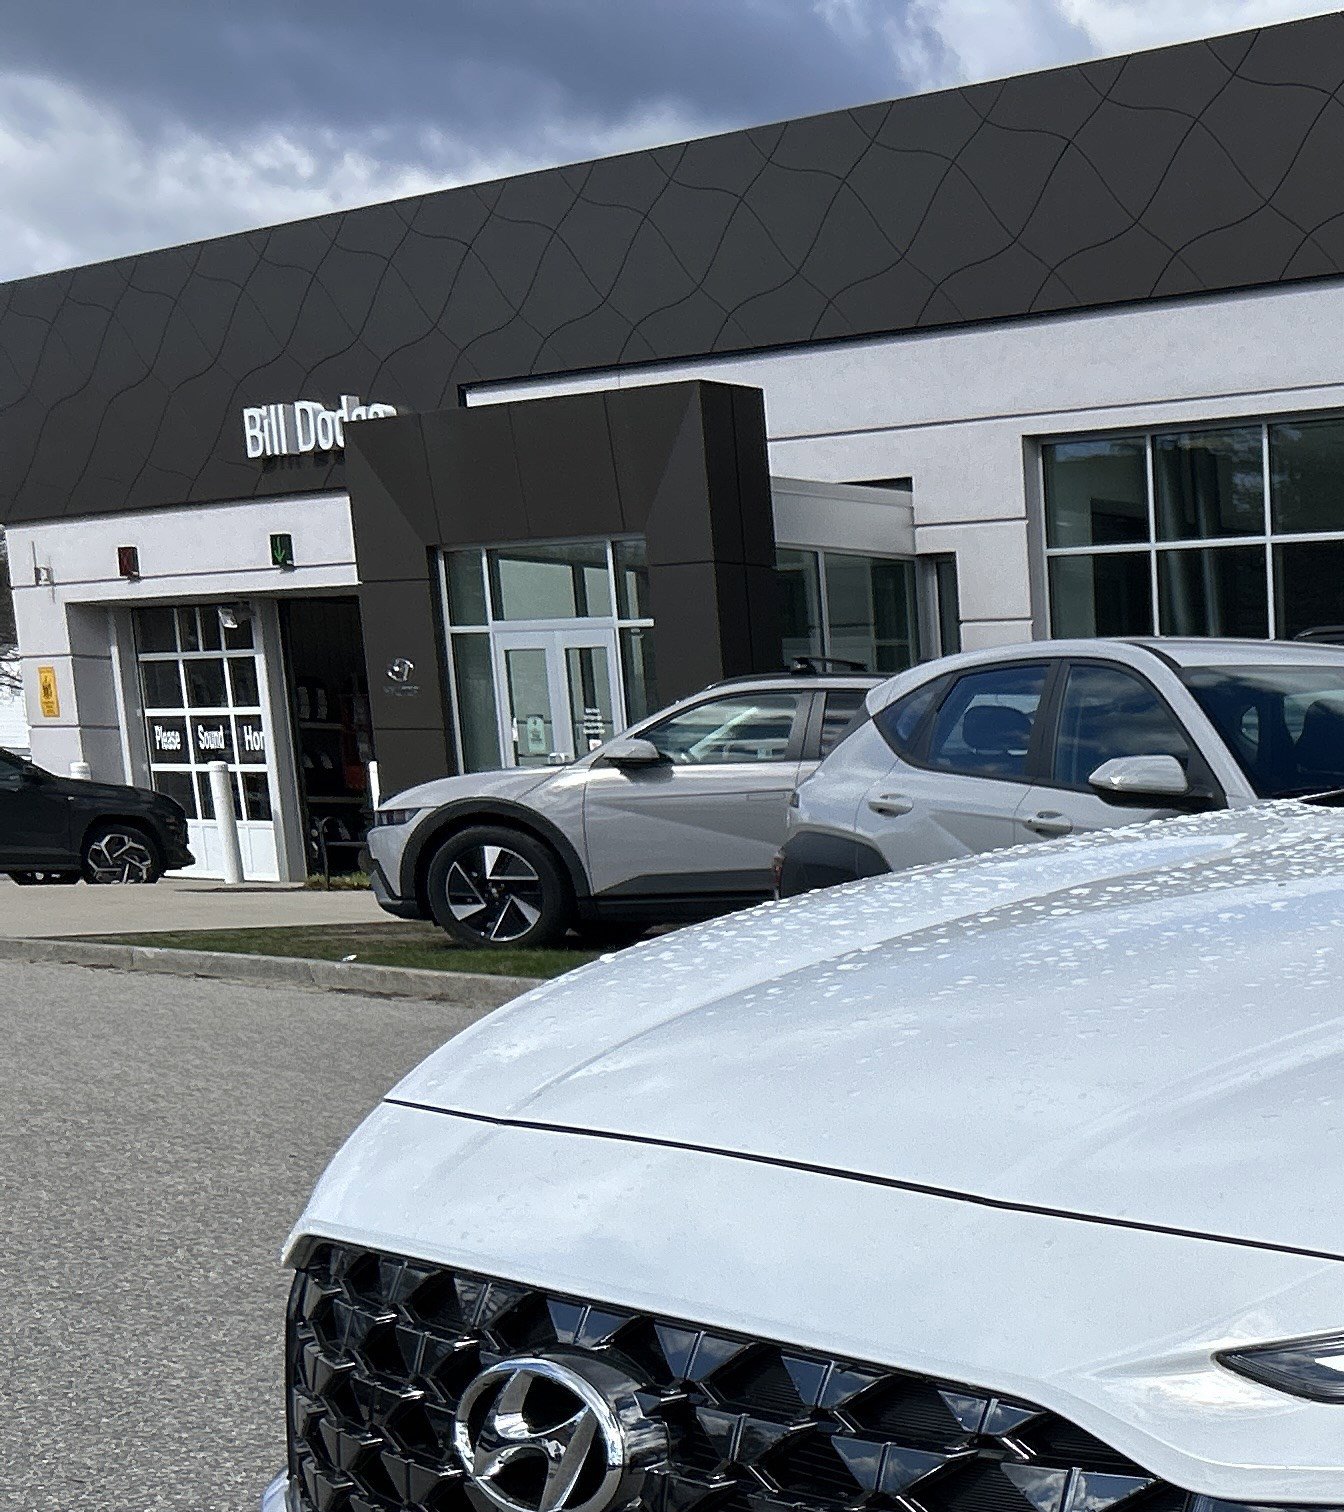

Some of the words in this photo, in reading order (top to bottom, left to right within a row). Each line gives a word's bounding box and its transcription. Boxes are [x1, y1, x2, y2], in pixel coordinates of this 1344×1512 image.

[243, 402, 290, 459] Bill
[294, 394, 398, 454] Dod
[154, 724, 181, 750] Please
[197, 724, 225, 750] Sound
[243, 725, 265, 751] Hor
